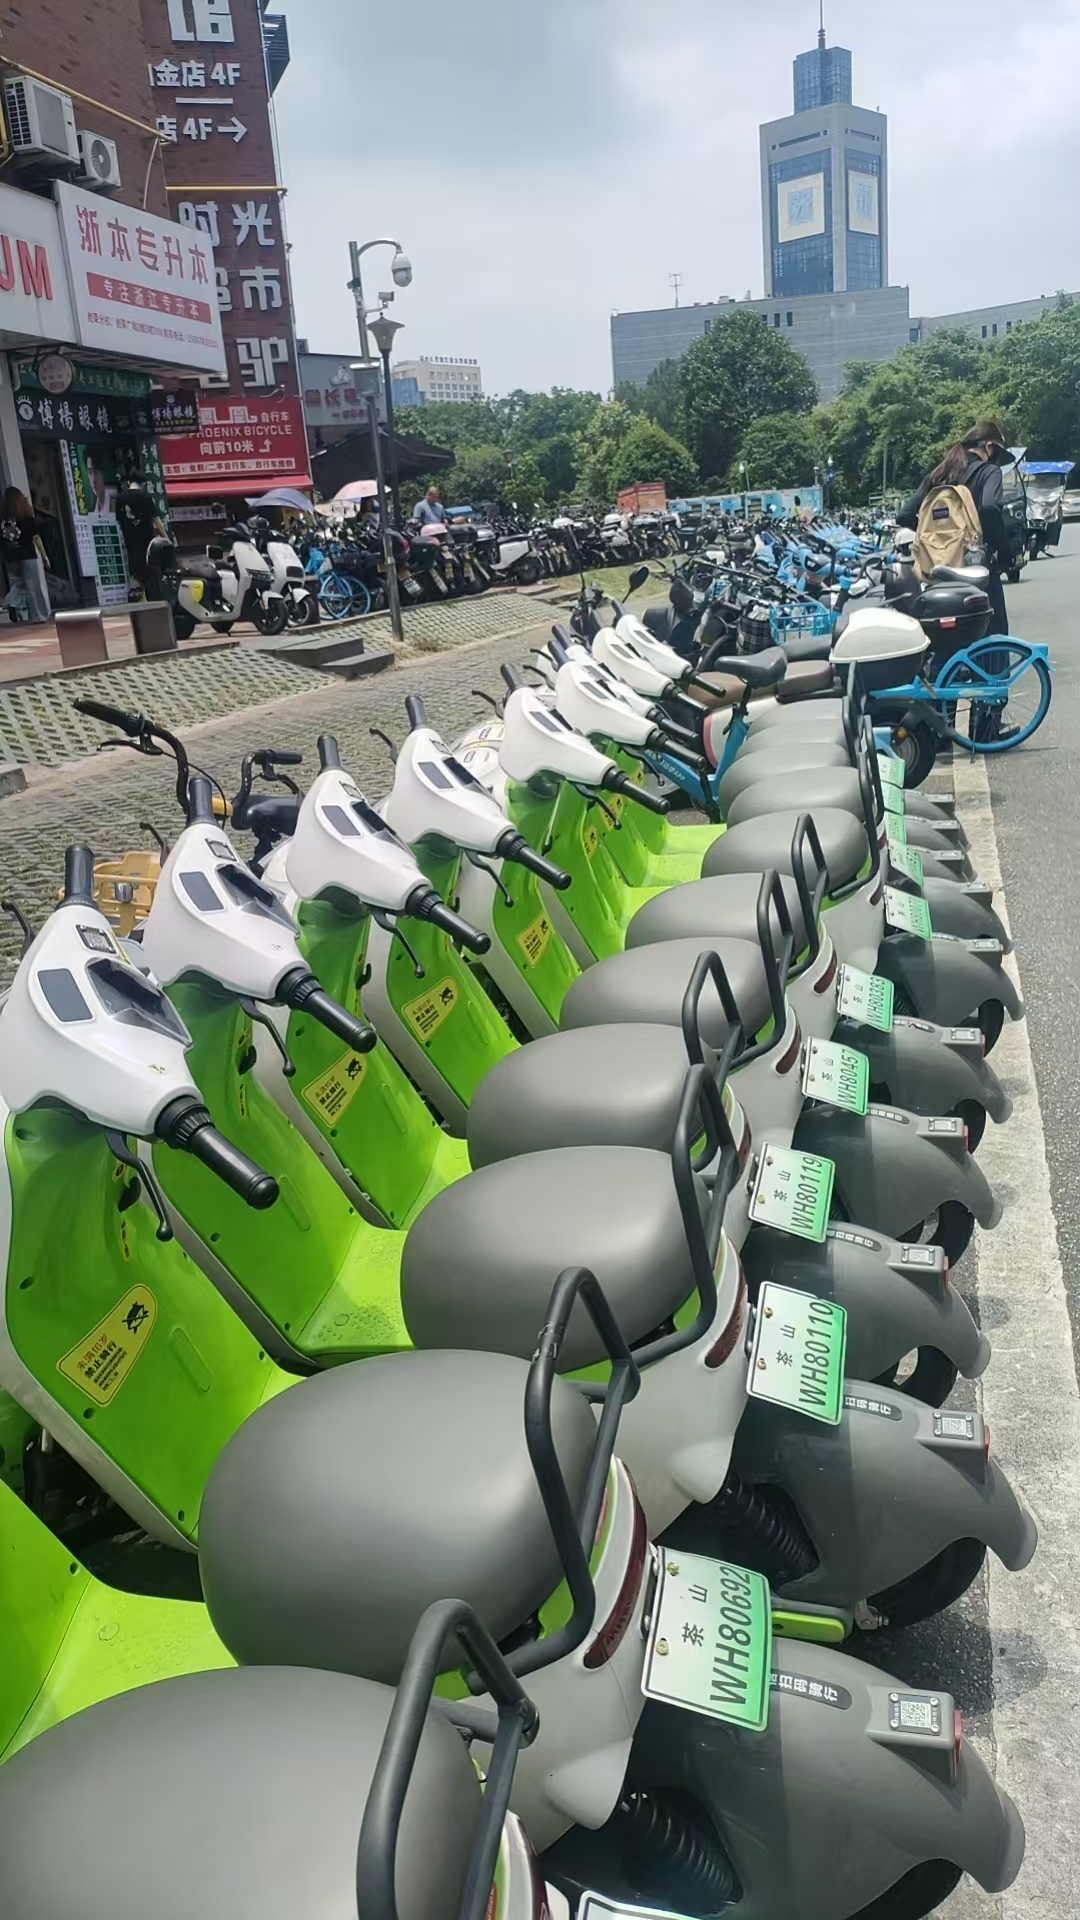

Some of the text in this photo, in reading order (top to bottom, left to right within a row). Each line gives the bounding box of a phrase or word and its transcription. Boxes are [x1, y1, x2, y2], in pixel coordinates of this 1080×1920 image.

[148, 58, 241, 87] 金店 4F
[183, 118, 212, 140] 4F
[76, 204, 209, 285] 浙本专升本
[179, 337, 289, 389] 驴
[200, 440, 254, 456] 向前10米
[244, 424, 293, 436] BICYCLE
[866, 976, 885, 1026] WH80383
[837, 1048, 858, 1106] WH80457
[791, 1156, 823, 1231] WH80119
[84, 1341, 118, 1379] 禁止骑行
[799, 1300, 834, 1408] WH80110
[709, 1565, 753, 1706] WH80692
